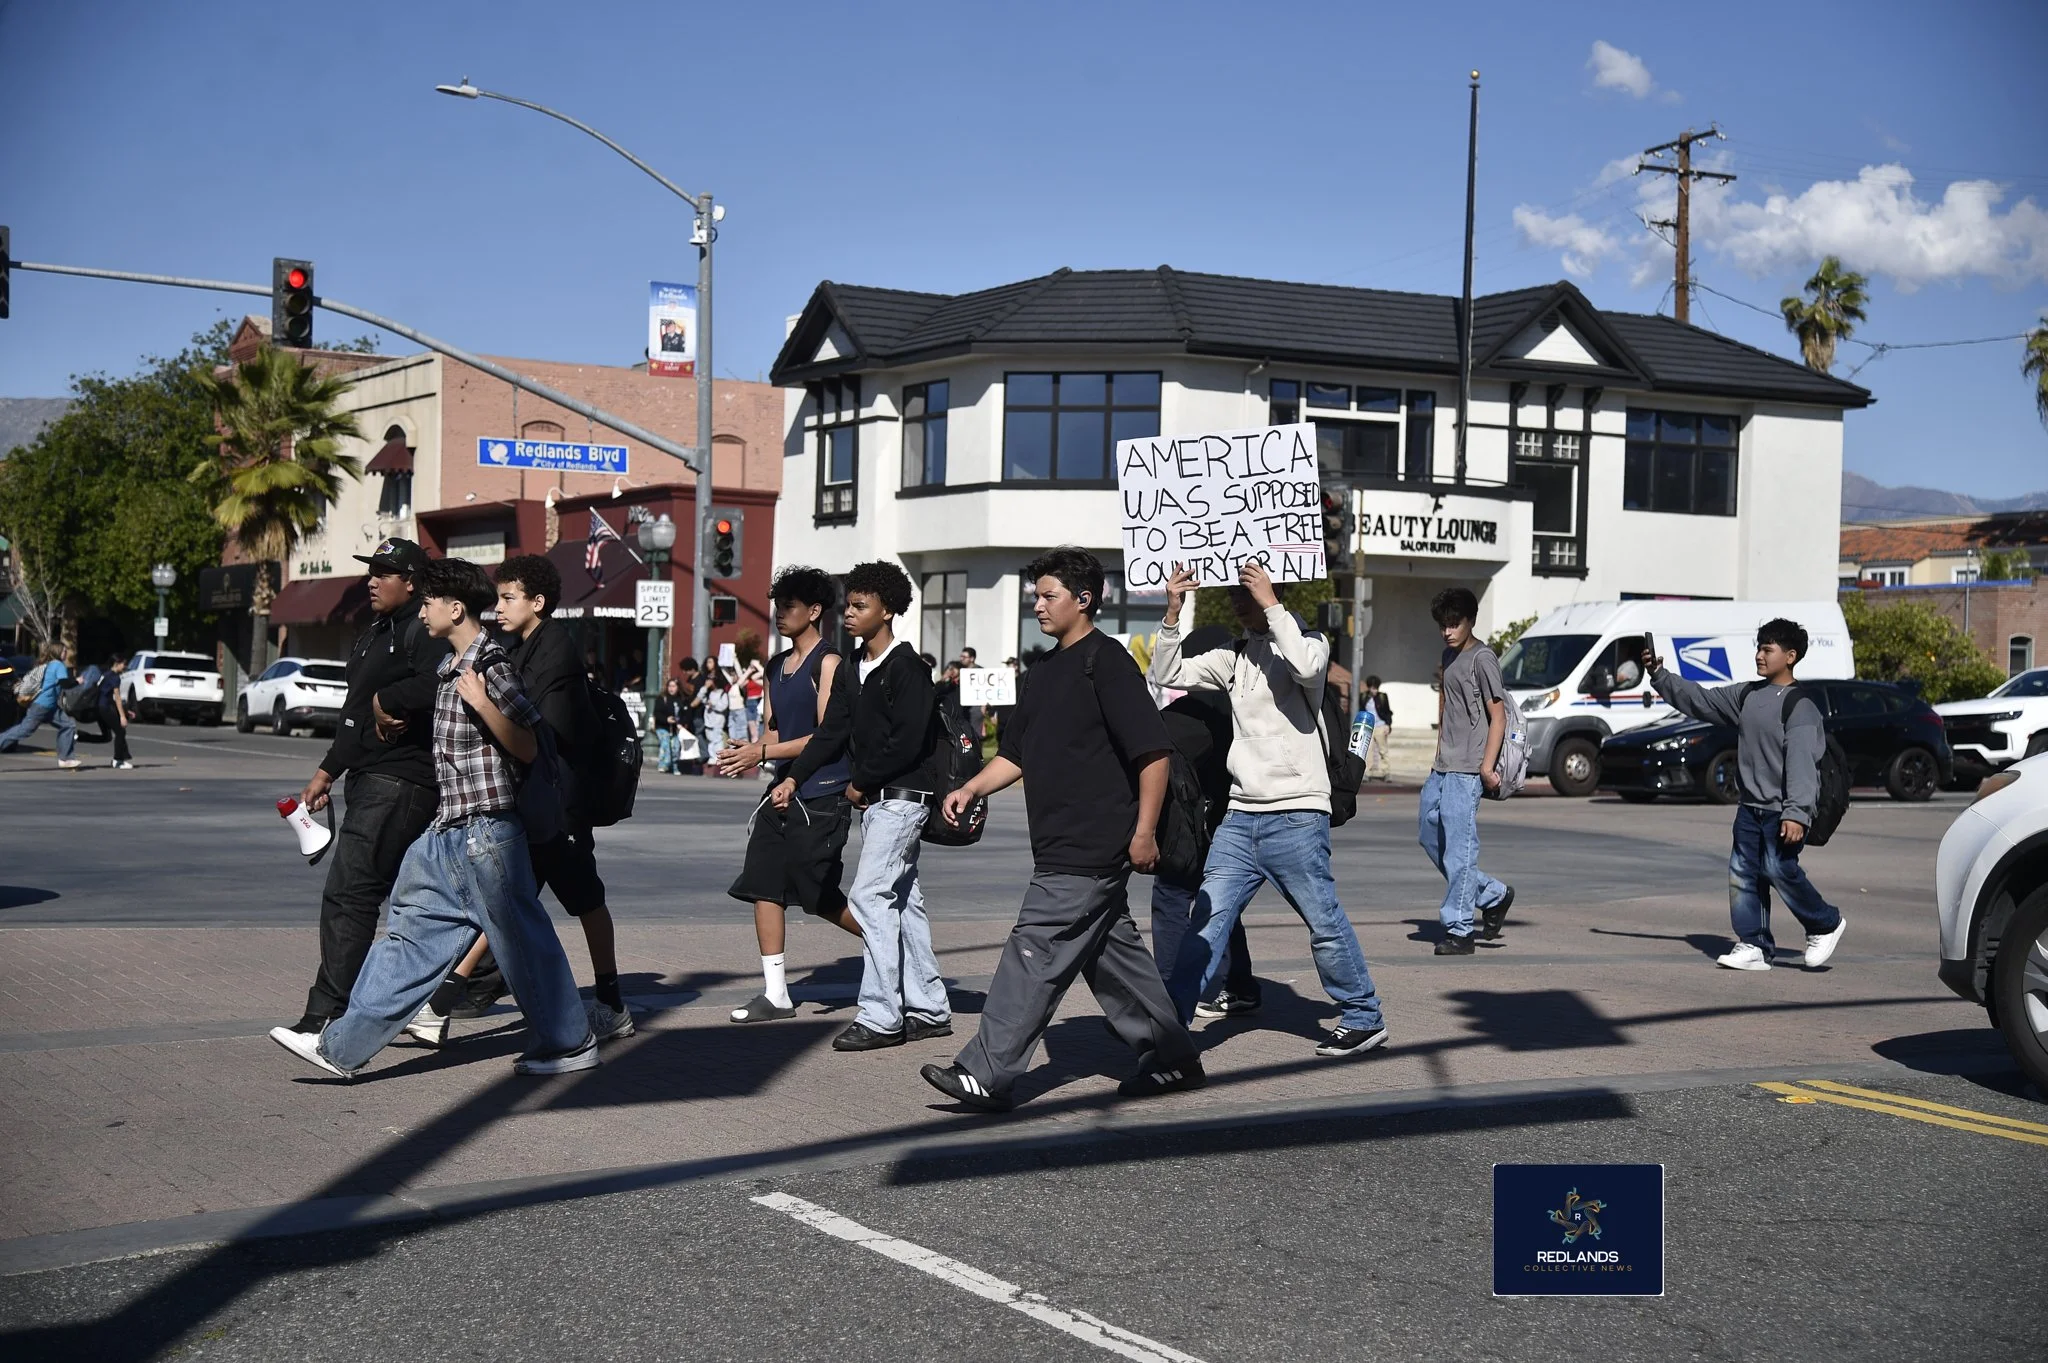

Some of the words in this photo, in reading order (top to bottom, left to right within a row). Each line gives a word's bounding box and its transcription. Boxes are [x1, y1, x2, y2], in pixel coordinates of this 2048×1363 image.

[515, 442, 582, 460] Redlands
[588, 446, 620, 463] Blvd
[1124, 429, 1314, 480] AMERICA
[1124, 485, 1210, 522] WAS
[1221, 480, 1320, 516] SUPPOSED
[1122, 526, 1167, 551] TO
[1172, 520, 1226, 549] BE
[1231, 520, 1253, 547] A
[1253, 512, 1323, 543] FREE
[1437, 518, 1497, 544] LOUNGE
[1400, 540, 1429, 553] SALON
[1429, 542, 1456, 554] SUITES
[641, 585, 670, 593] SPEED
[641, 605, 670, 622] 25
[969, 673, 1007, 686] FUCK
